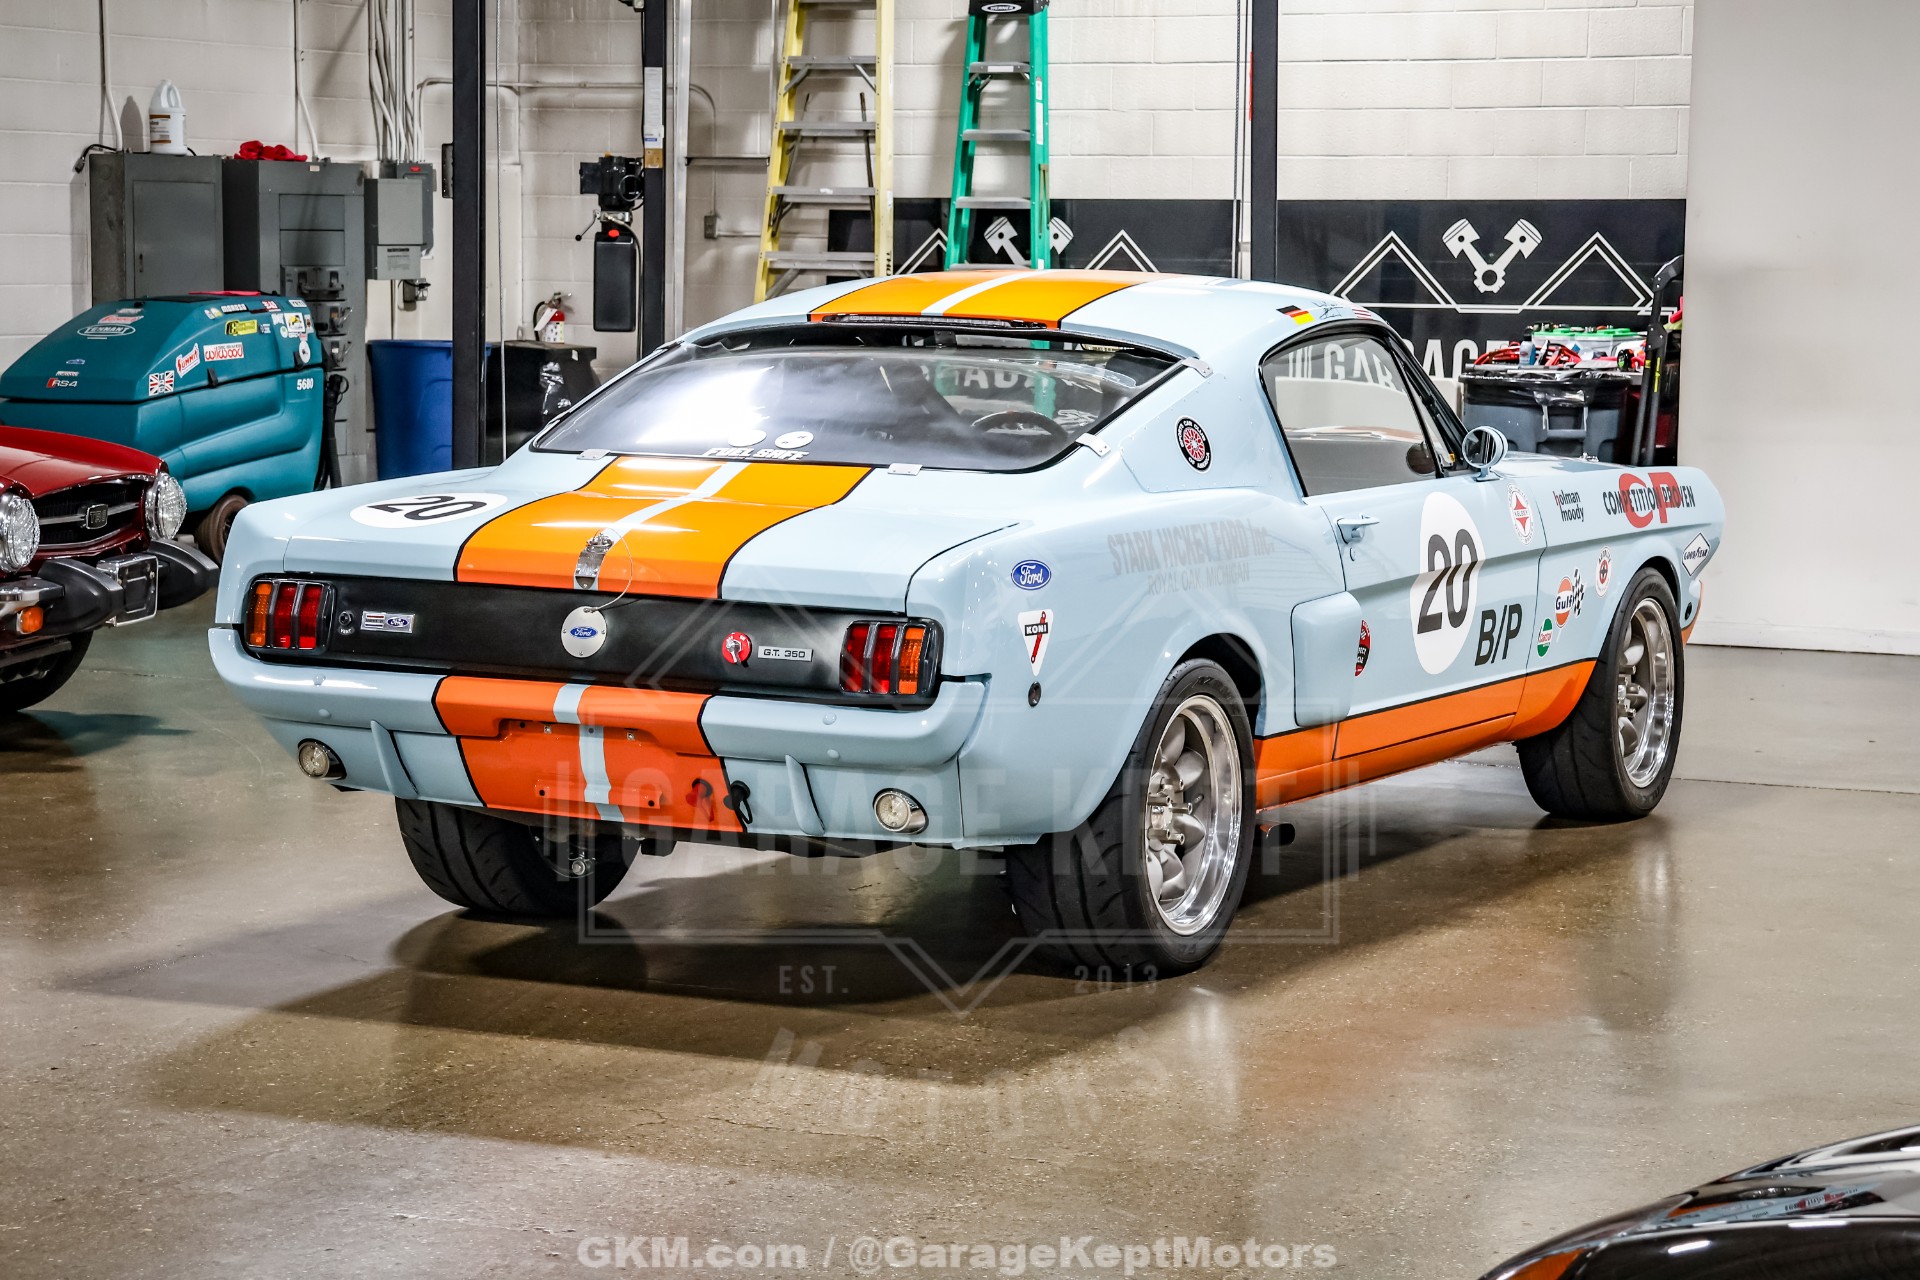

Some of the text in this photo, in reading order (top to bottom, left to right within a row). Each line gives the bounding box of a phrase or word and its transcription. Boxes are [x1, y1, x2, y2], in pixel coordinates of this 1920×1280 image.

[84, 326, 130, 334] TENNANT
[177, 349, 199, 372] SUMMIT
[51, 379, 78, 388] RS4
[296, 378, 314, 391] 5680
[702, 447, 810, 460] FUEL SAFE
[1552, 490, 1581, 506] holman
[1602, 485, 1696, 516] COMPETITION PROVEN
[366, 495, 487, 521] 20
[1559, 504, 1584, 523] moody
[1107, 529, 1160, 576] STARK
[1210, 519, 1250, 561] FORD
[1019, 564, 1045, 585] Ford
[1147, 570, 1180, 596] ROYAL
[1205, 562, 1250, 588] MICHIGAN
[1417, 528, 1479, 635] 20
[1555, 594, 1573, 611] Gulf
[572, 626, 596, 639] Ford
[1025, 623, 1048, 635] KONI
[1474, 602, 1523, 667] B/P
[763, 648, 806, 659] G.T. 350
